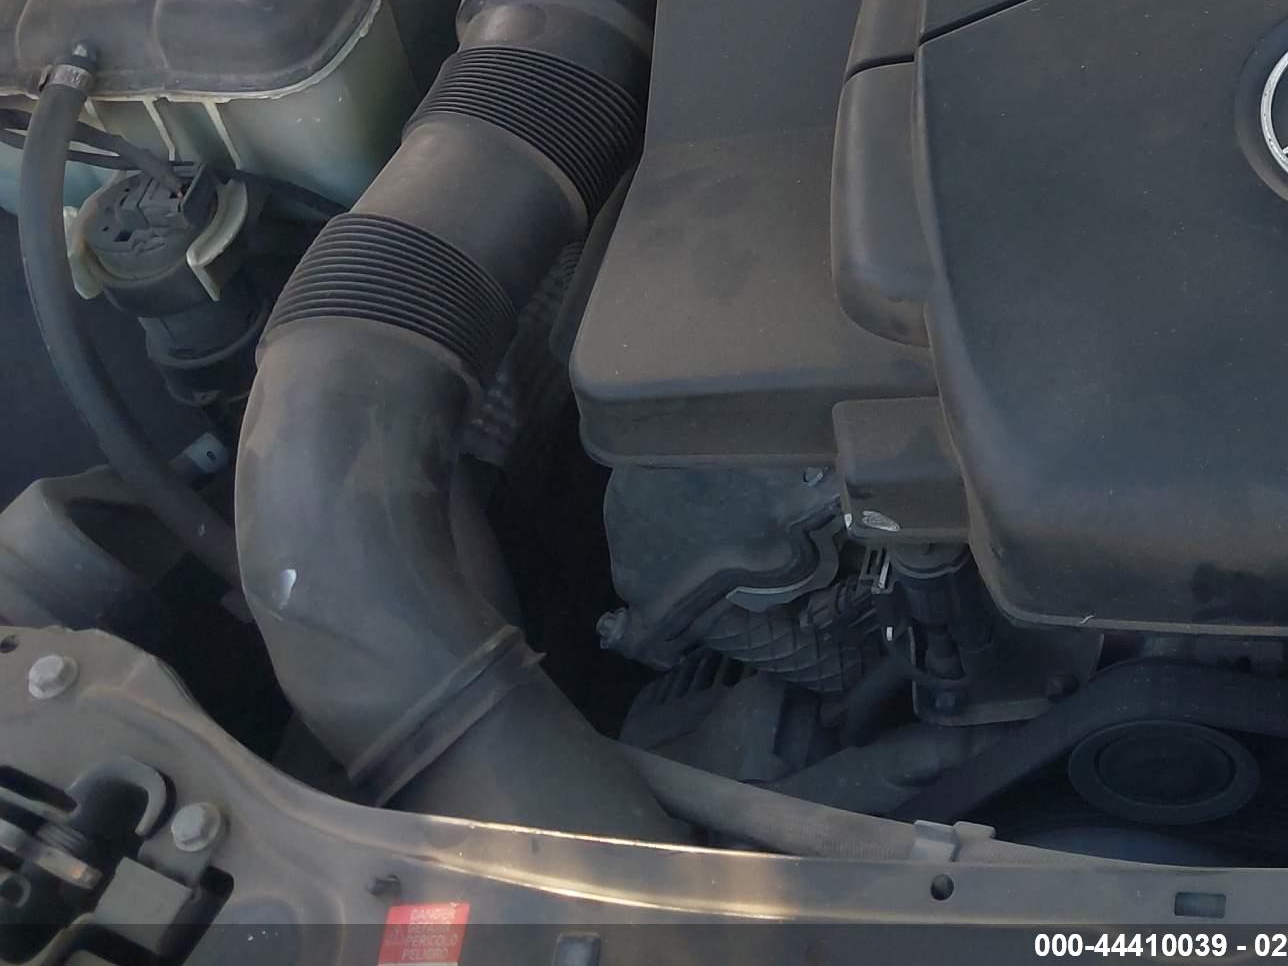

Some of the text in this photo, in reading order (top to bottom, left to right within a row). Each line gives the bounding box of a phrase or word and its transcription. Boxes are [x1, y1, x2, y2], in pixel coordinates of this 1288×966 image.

[410, 908, 457, 921] DANGER
[405, 934, 459, 947] PERICOLO
[401, 947, 449, 961] PELIGRO
